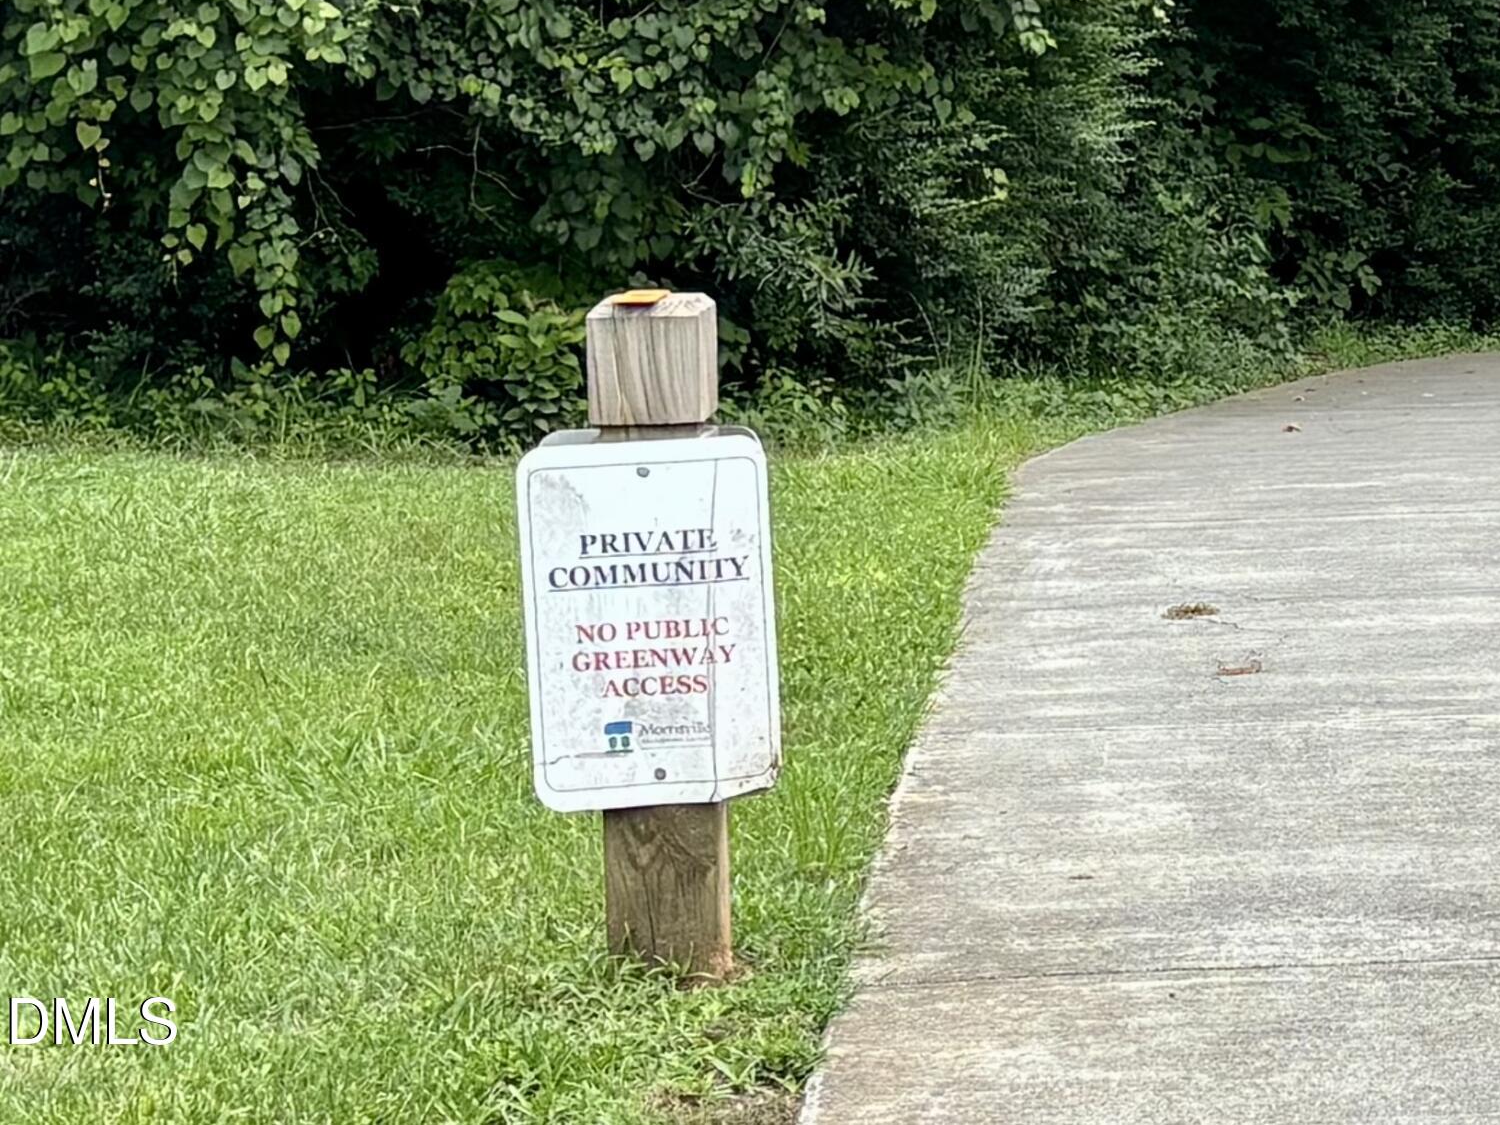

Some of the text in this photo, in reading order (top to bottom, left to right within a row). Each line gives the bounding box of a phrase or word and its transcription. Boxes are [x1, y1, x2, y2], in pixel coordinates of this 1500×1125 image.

[579, 528, 718, 556] PRIVATE
[549, 555, 749, 589] COMMUNITY
[575, 616, 730, 644] NO PUBLIC
[572, 643, 736, 673] GREENWAY
[602, 674, 708, 698] ACCESS
